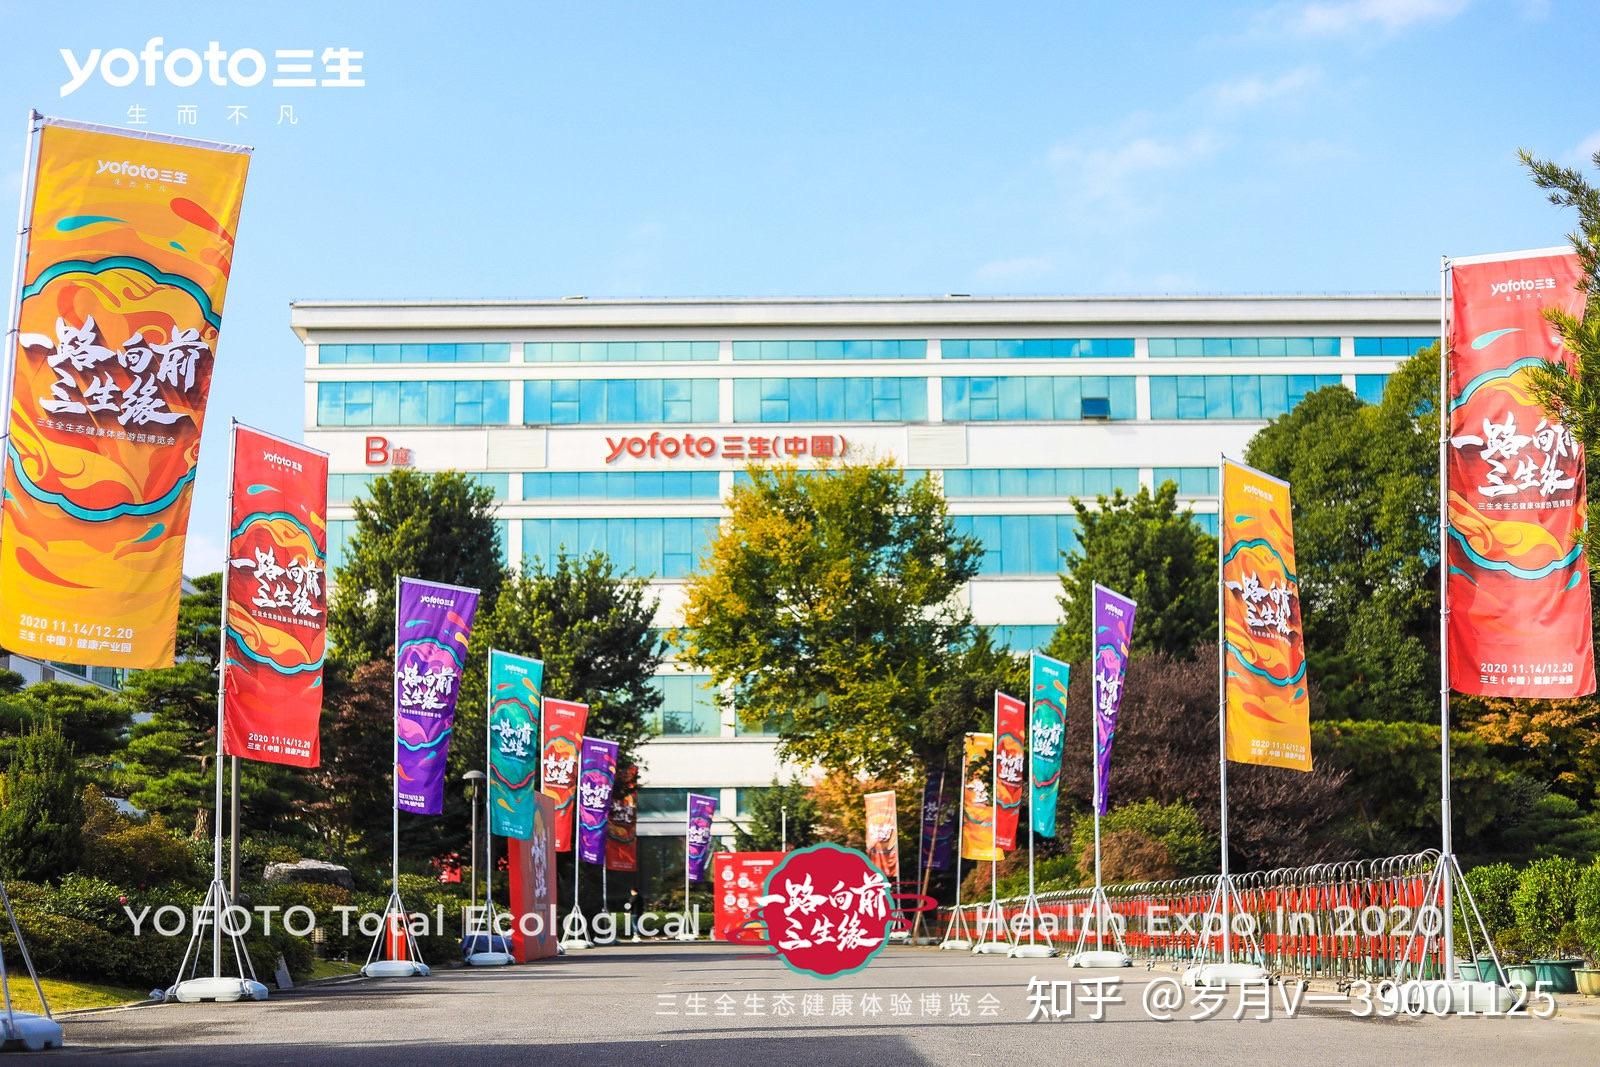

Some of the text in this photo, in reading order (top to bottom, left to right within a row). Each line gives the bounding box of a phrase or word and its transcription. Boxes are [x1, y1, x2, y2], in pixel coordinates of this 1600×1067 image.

[19, 314, 209, 392] 一路向前
[39, 367, 190, 425] 三生缘
[230, 546, 323, 599] 一路向前
[19, 613, 134, 639] 2020 11.14/12.20
[1480, 662, 1574, 674] 2020 11.14/12.20
[248, 732, 269, 743] 2020
